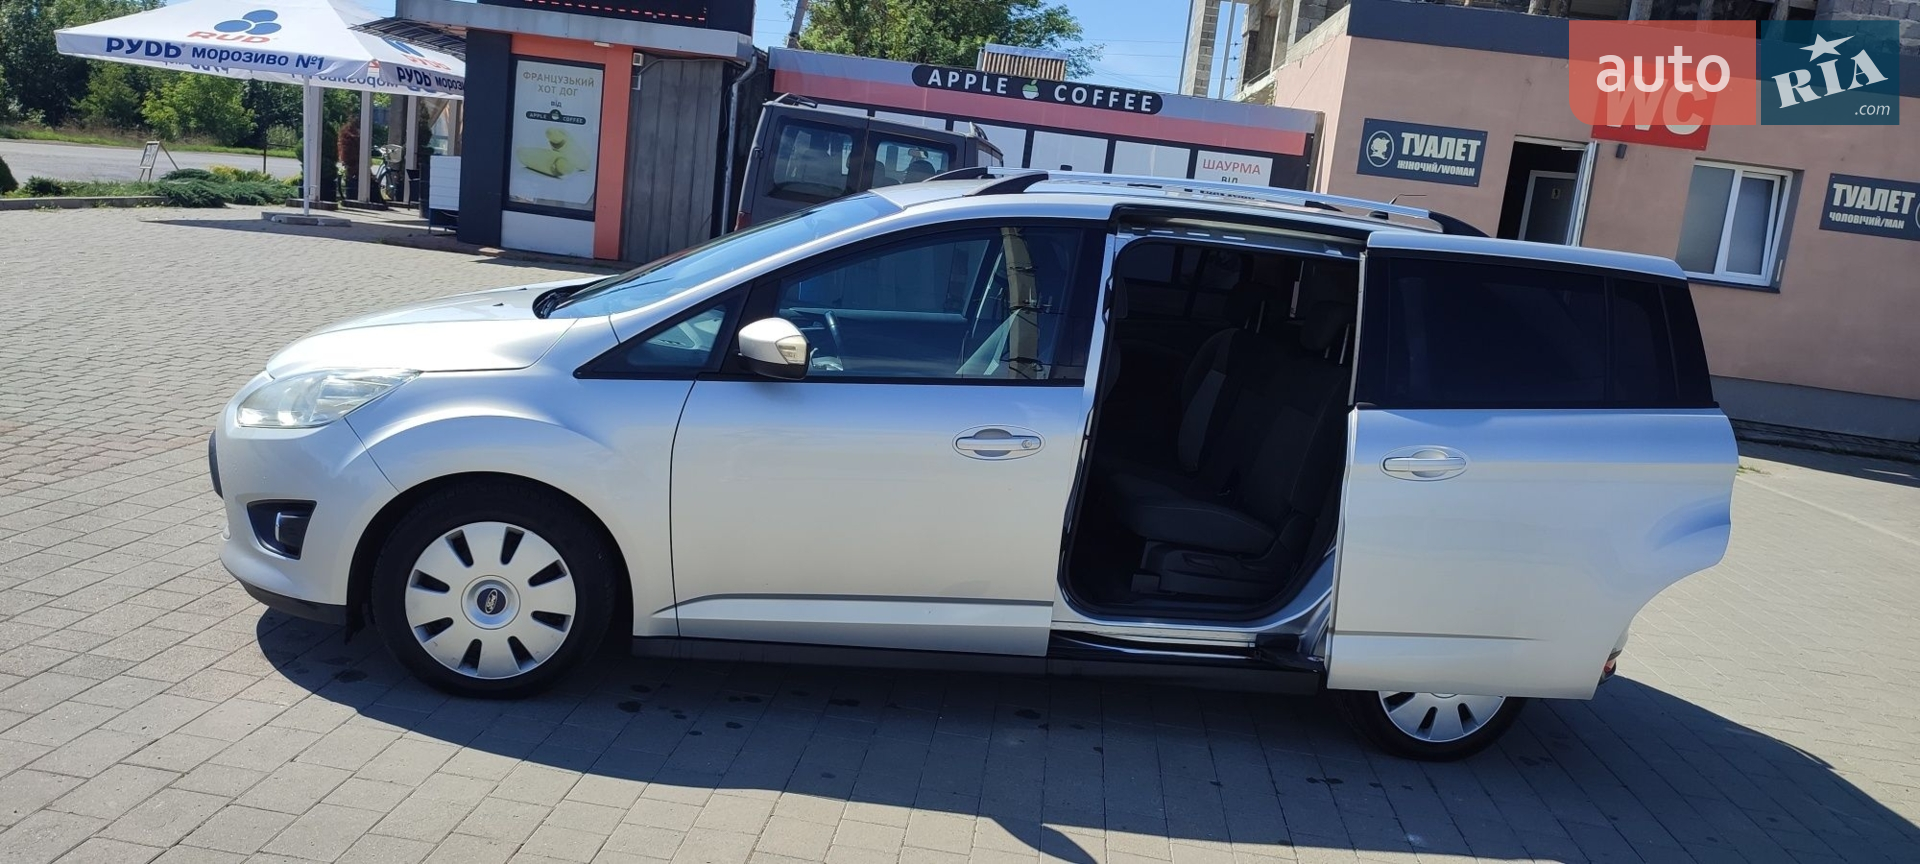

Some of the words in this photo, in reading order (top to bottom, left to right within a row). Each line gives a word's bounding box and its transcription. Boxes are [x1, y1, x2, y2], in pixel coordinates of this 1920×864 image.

[187, 31, 271, 43] RUD
[191, 46, 289, 67] морозиво
[523, 71, 595, 88] ФРАНЦУЗЬКИЙ
[537, 84, 557, 94] ХОТ
[559, 86, 579, 97] ДОГ
[927, 68, 1009, 94] APPLE
[1053, 84, 1154, 112] COFFEE
[1606, 73, 1708, 135] WC
[562, 116, 584, 124] COFFEE
[1401, 132, 1481, 162] ТУАЛЕТ
[1202, 159, 1261, 175] ШАУРМА
[1833, 183, 1916, 214] ТУАЛЕТ
